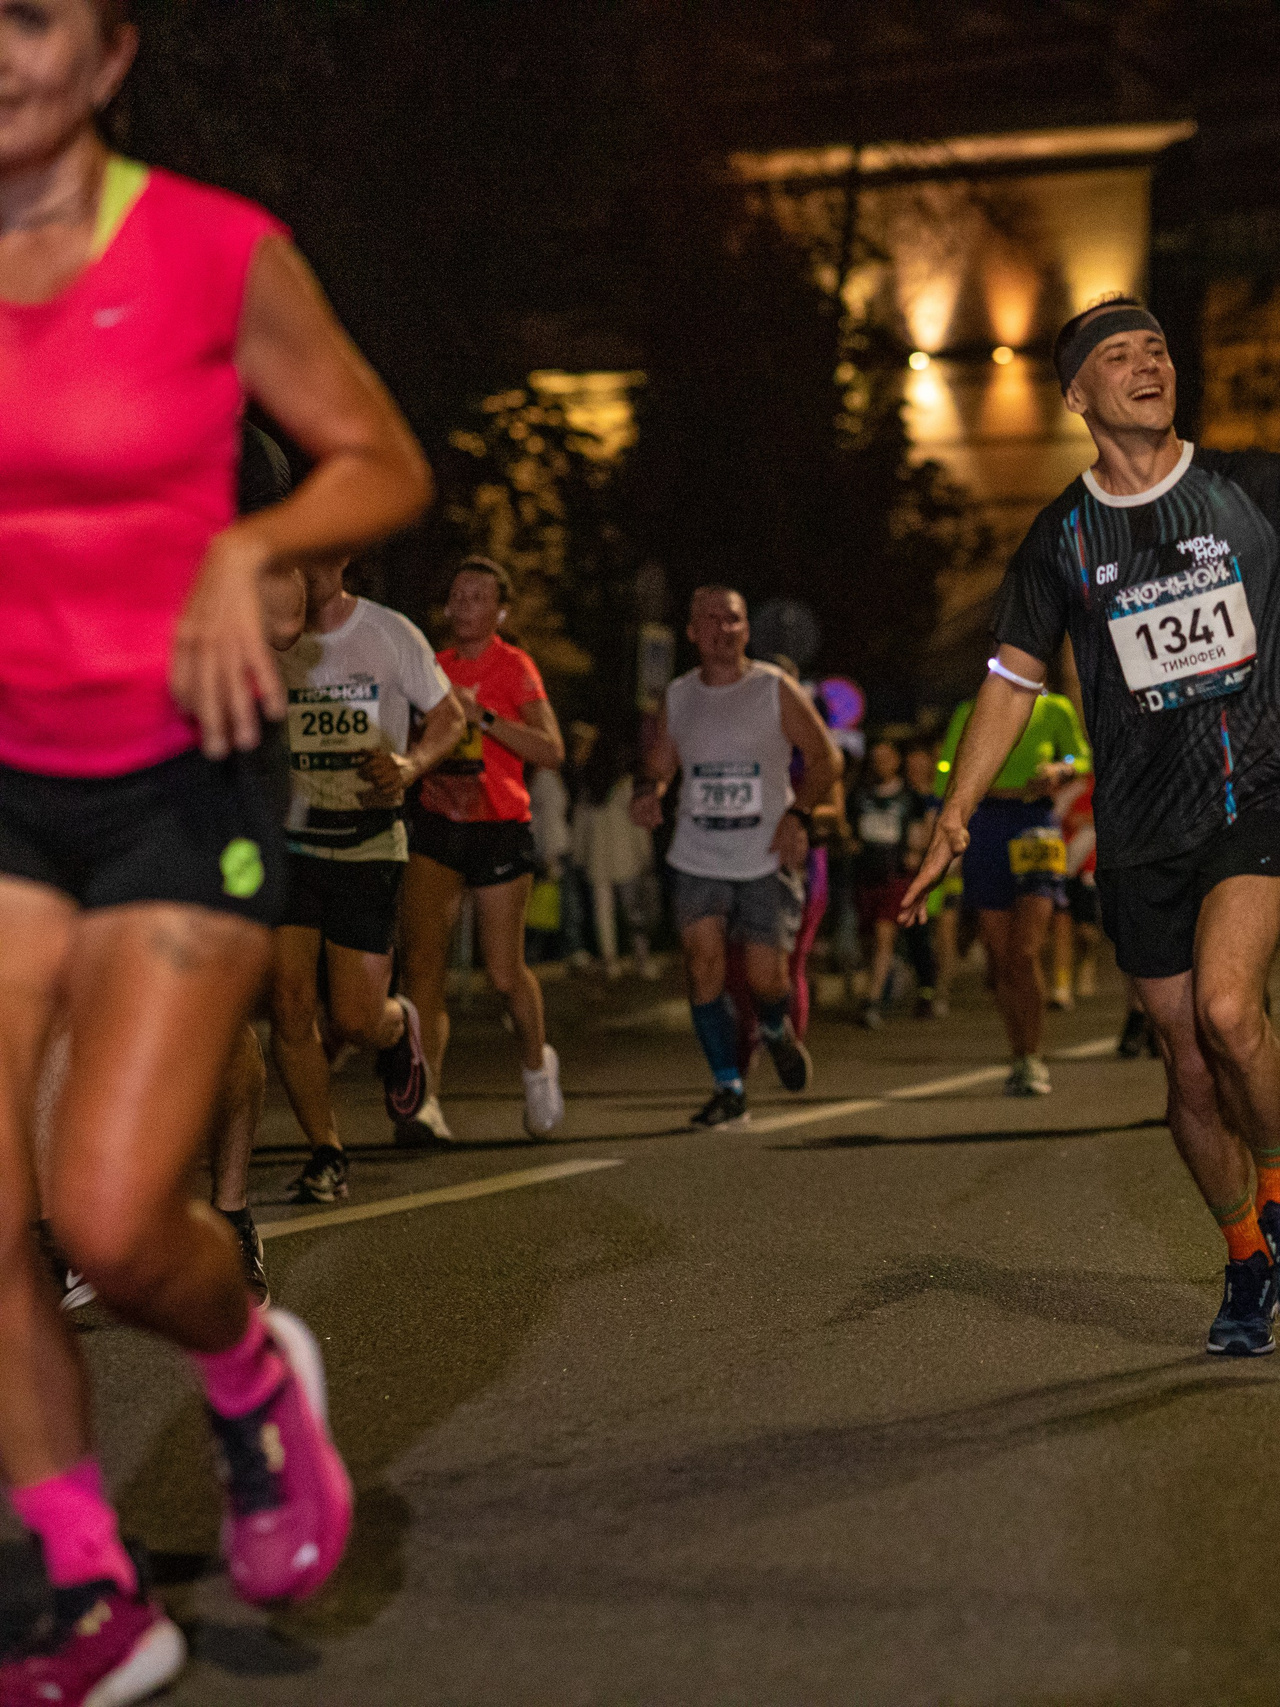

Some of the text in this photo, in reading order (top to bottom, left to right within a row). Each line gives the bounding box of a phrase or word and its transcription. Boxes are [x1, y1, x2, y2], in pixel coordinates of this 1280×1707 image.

[1135, 600, 1235, 660] 1341
[1161, 644, 1227, 673] ТИМОФЕЙ
[301, 709, 369, 736] 2868
